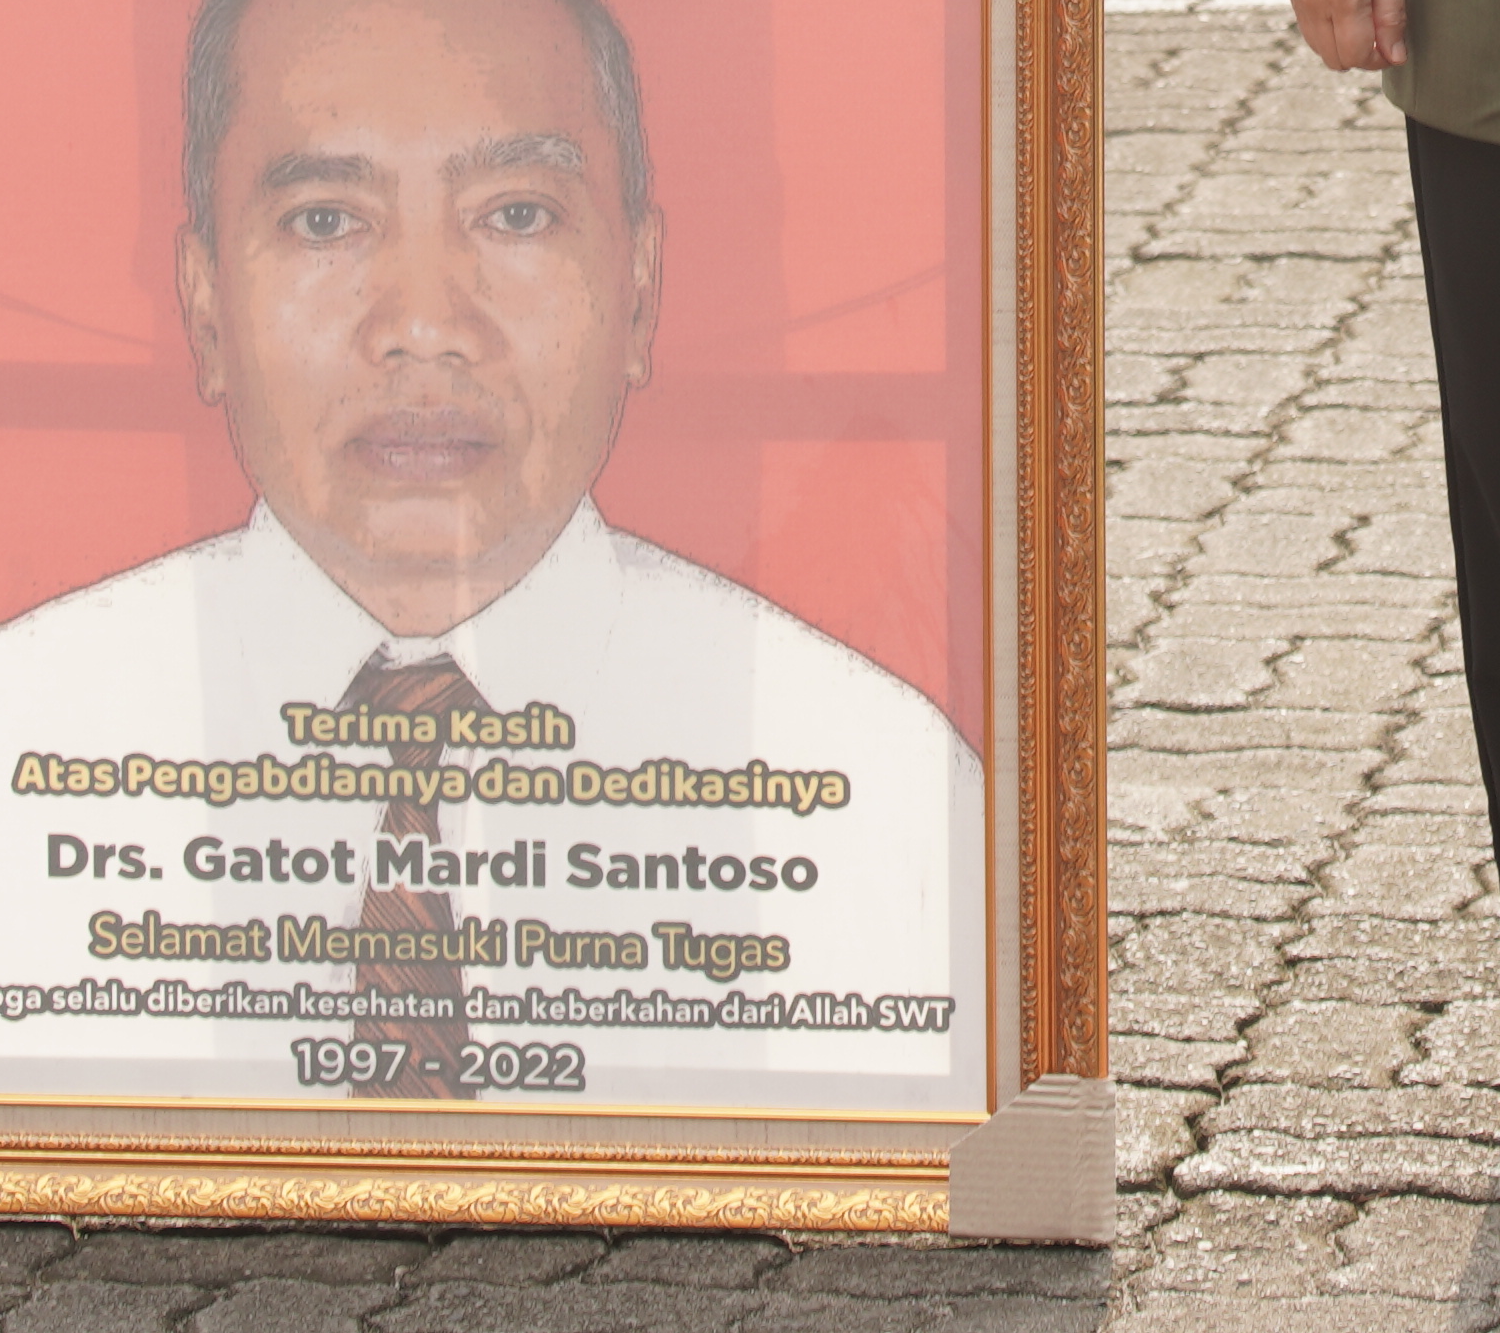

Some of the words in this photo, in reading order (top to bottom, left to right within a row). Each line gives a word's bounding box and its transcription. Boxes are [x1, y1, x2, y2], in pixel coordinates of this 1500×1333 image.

[286, 704, 437, 744] Terima
[450, 705, 571, 746] Kasih
[16, 755, 116, 793] Atas
[127, 756, 468, 806] Pengabdiannya
[477, 762, 561, 801] dan
[571, 762, 847, 813] Dedikasinya
[48, 834, 162, 880] Drs.
[183, 836, 355, 883] Gatot
[376, 840, 546, 887] Mardi
[566, 843, 819, 892] Santoso
[92, 914, 269, 958] Selamat
[281, 919, 502, 962] Memasuki
[520, 924, 644, 966] Purna
[657, 926, 788, 978] Tugas
[52, 981, 138, 1013] selalu
[146, 982, 289, 1015] diberikan
[298, 986, 455, 1019] kesehatan
[464, 989, 521, 1021] dan
[531, 992, 711, 1025] keberkahan
[720, 996, 781, 1026] dari
[790, 997, 869, 1027] Allah
[878, 999, 952, 1029] SWT
[295, 1041, 409, 1082] 1997
[459, 1044, 582, 1086] 2022
